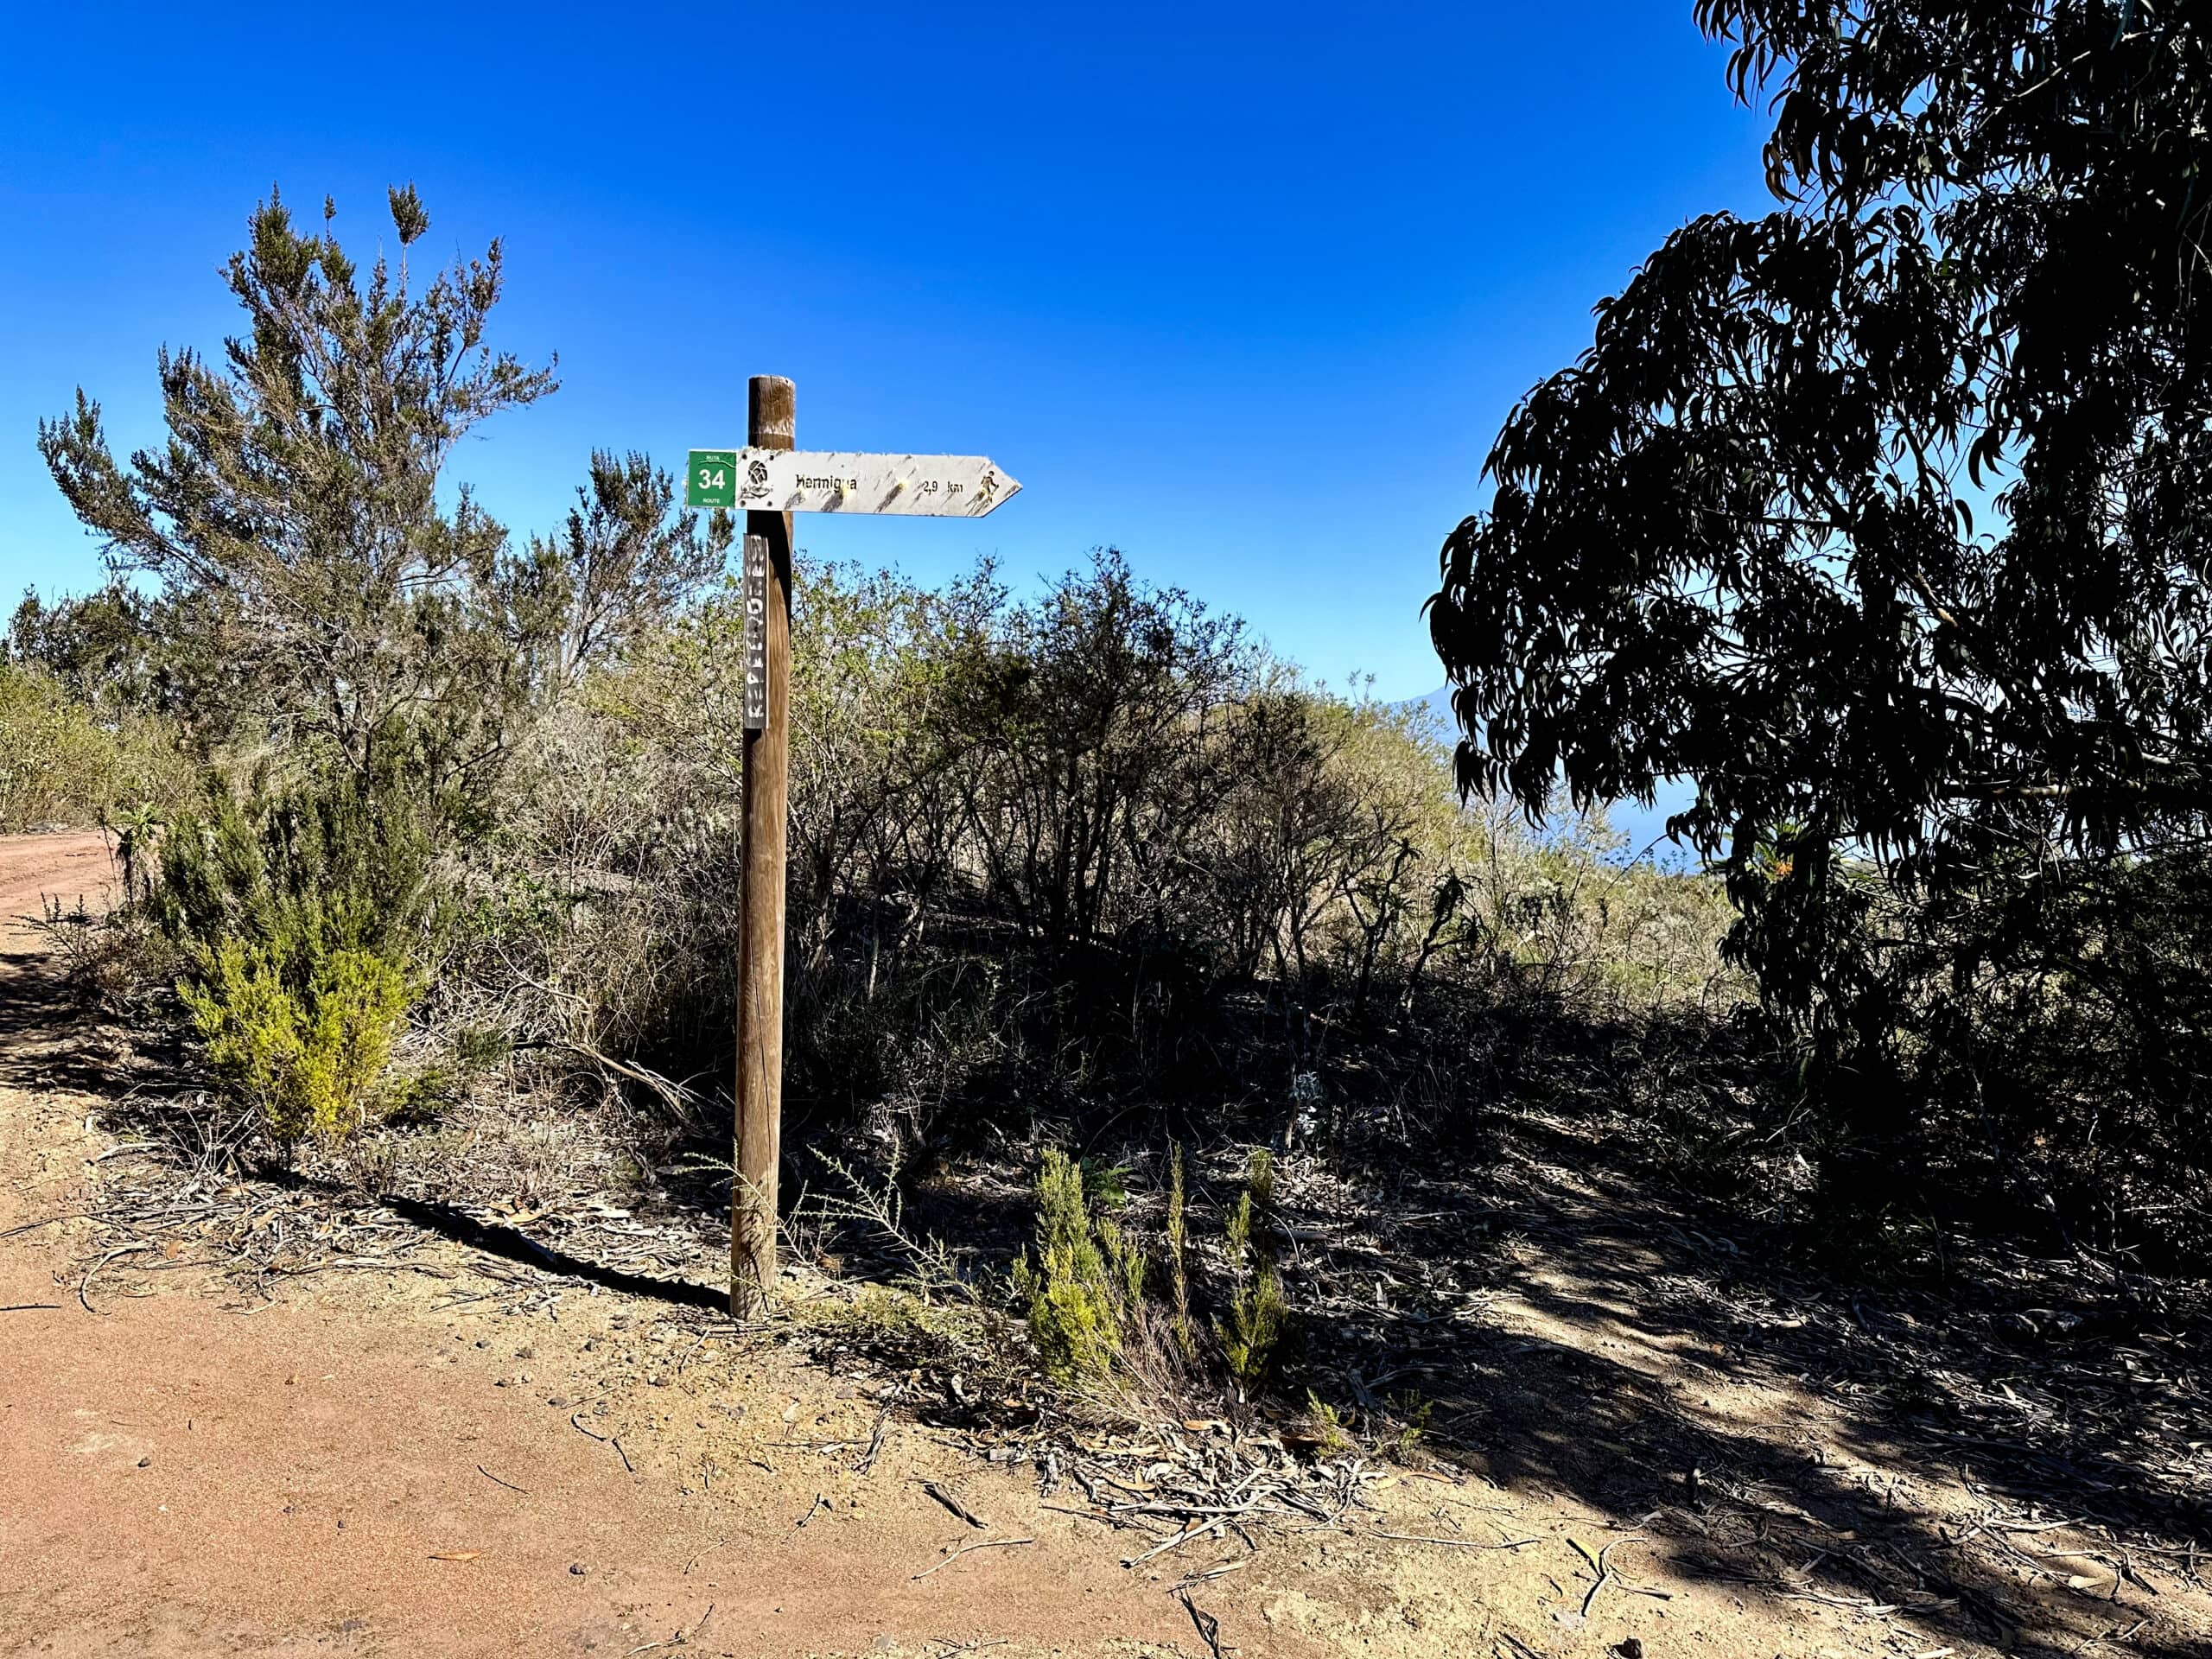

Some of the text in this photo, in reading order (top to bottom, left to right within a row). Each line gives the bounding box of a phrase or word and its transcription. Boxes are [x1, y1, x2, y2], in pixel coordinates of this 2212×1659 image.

[698, 469, 726, 490] 34
[923, 480, 963, 493] 2,9 km
